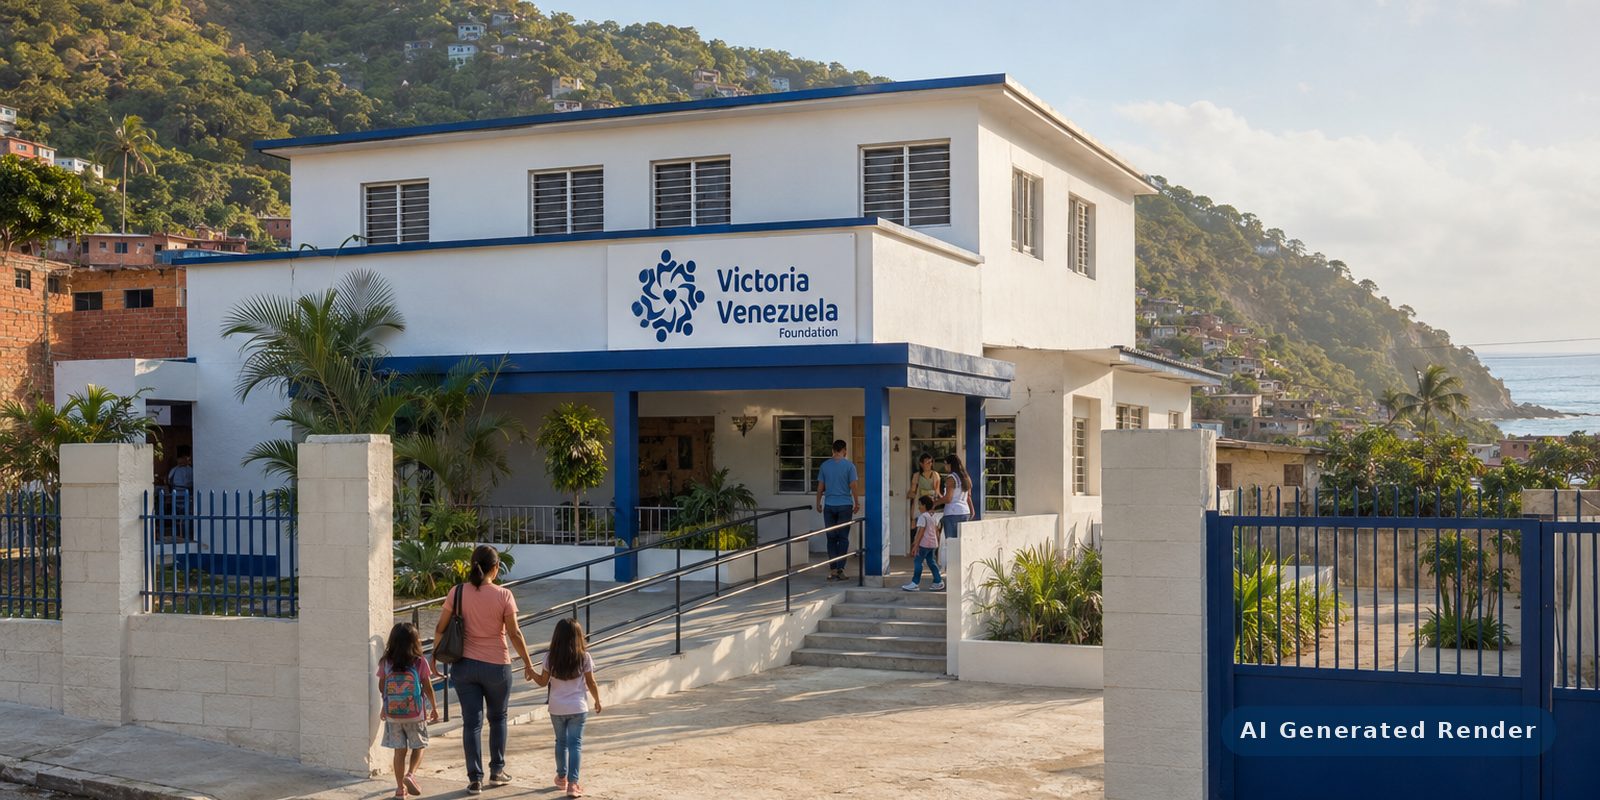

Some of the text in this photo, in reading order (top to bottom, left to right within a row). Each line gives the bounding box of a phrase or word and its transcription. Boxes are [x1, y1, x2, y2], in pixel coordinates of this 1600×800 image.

[716, 266, 810, 293] Victoria
[716, 298, 839, 324] Venezuela
[779, 326, 839, 339] Foundation
